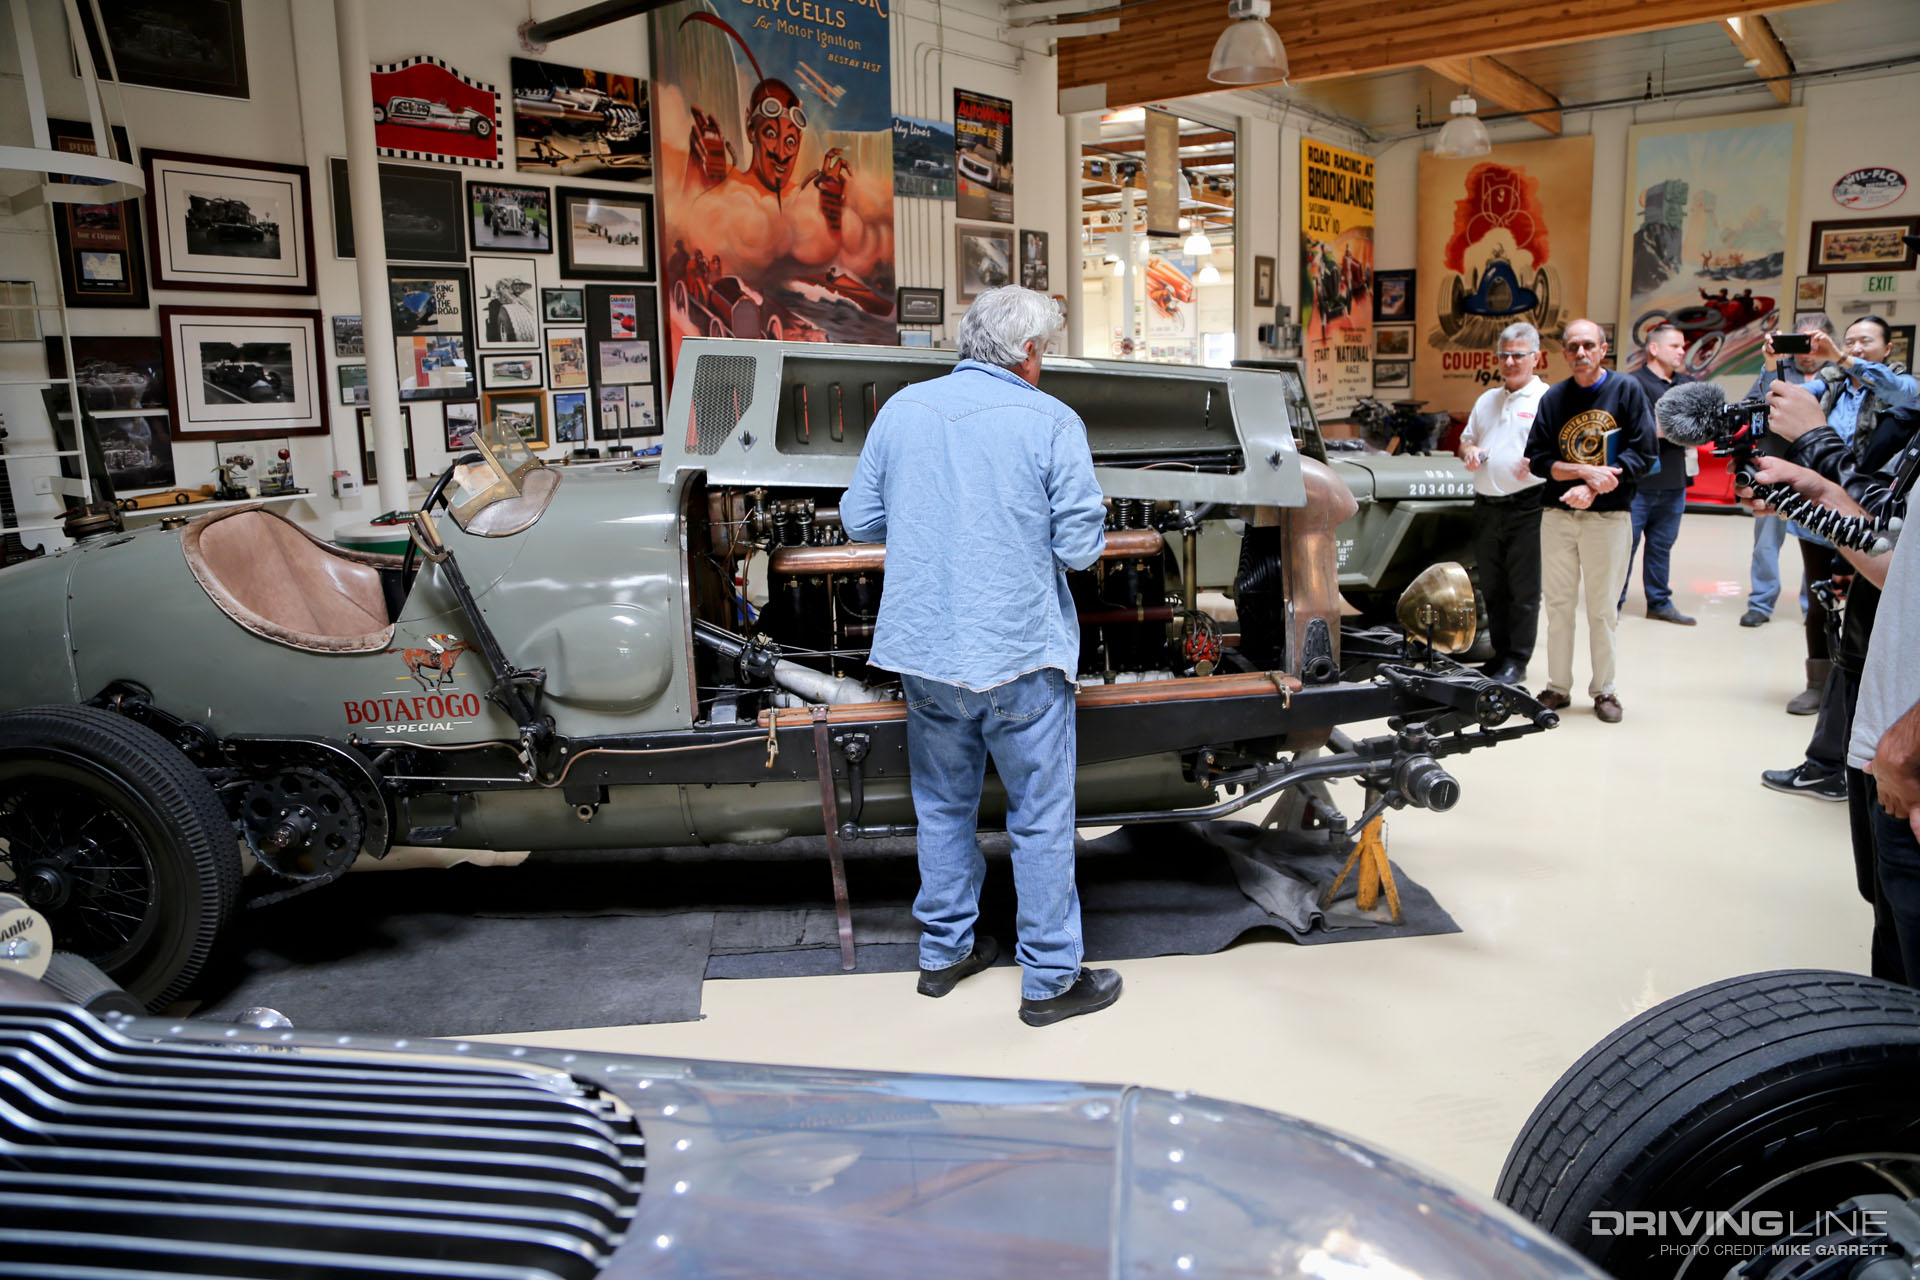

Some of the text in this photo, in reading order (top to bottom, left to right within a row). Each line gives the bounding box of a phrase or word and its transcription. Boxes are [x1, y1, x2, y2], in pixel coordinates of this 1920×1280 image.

[786, 0, 846, 28] CELLS
[752, 15, 862, 50] for Motor Ignition
[1308, 145, 1374, 177] ROAD RACING AT
[1308, 166, 1375, 211] BROOKLANDS
[1308, 214, 1330, 233] JULY
[435, 285, 454, 293] KING
[1868, 275, 1894, 292] EXIT
[436, 292, 447, 300] OF
[437, 300, 451, 308] THE
[437, 307, 459, 315] ROAD
[1313, 347, 1330, 363] START
[1442, 351, 1492, 371] COUPE
[1475, 369, 1507, 386] 194
[1561, 413, 1588, 441] UNITED
[1409, 483, 1475, 496] 2034042
[344, 693, 481, 725] BOTAFOGO
[384, 722, 455, 734] SPECIAL
